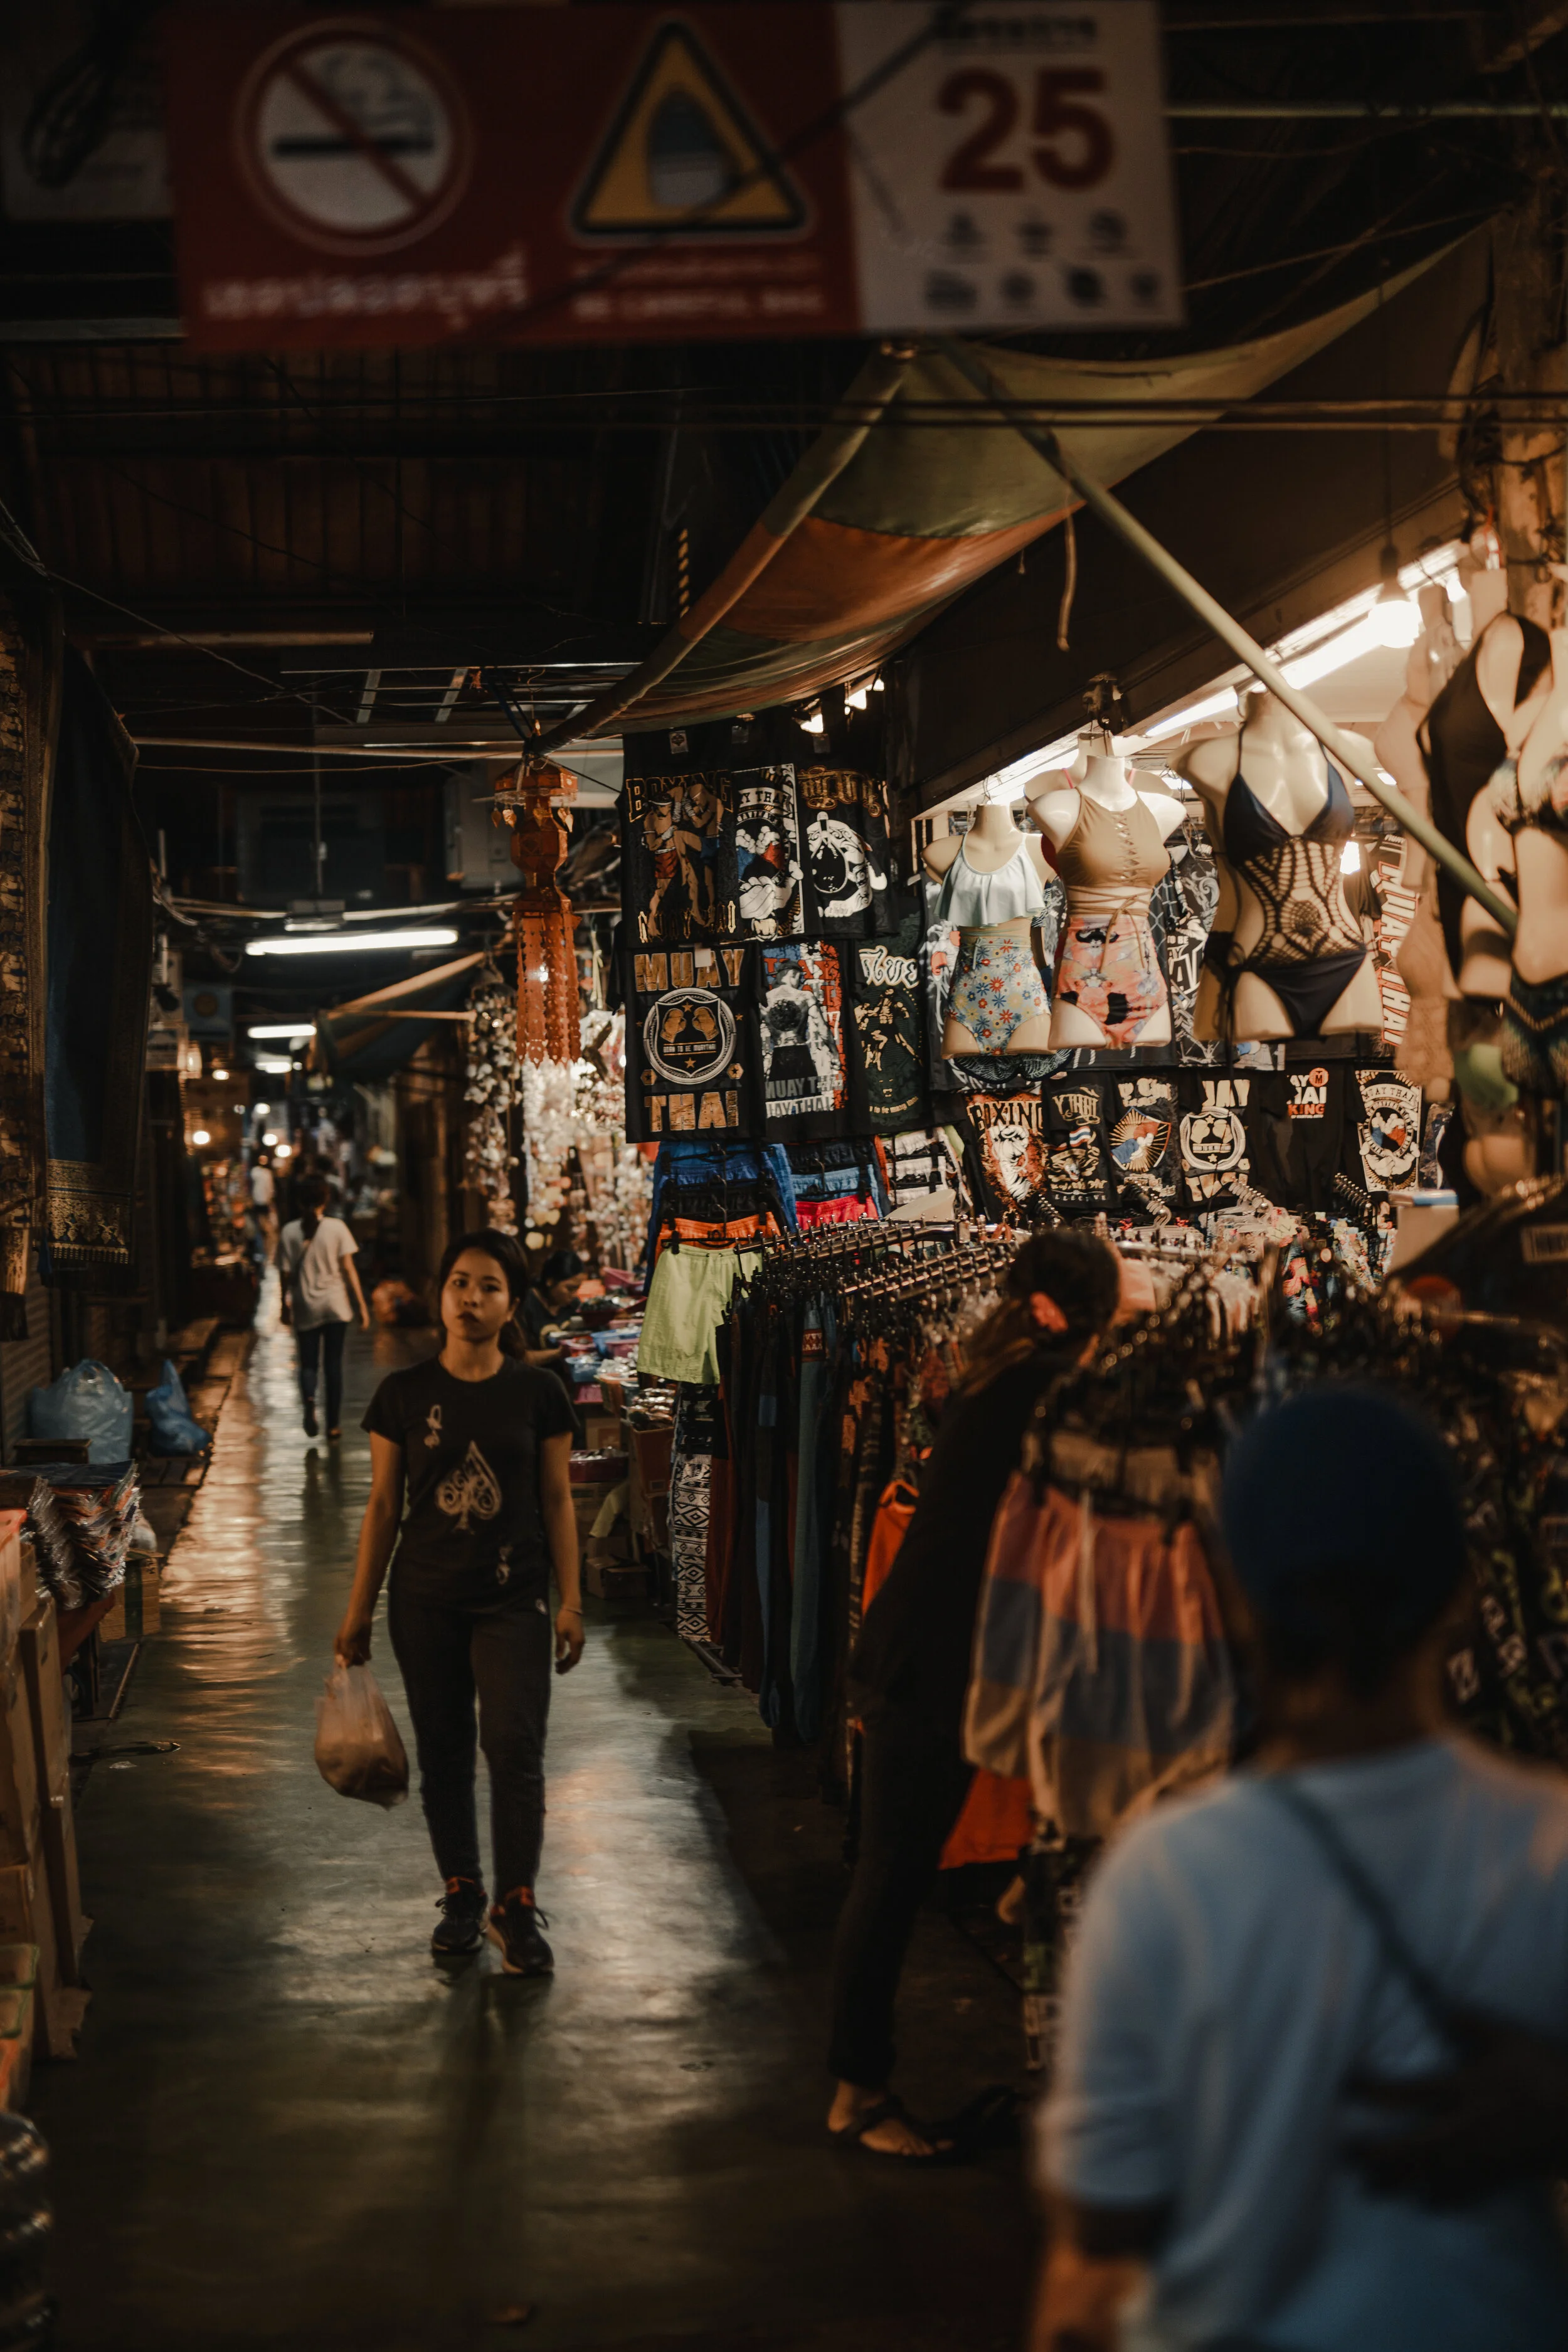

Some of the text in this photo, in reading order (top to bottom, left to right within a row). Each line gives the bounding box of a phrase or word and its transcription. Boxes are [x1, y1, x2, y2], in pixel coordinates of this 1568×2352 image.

[937, 66, 1115, 193] 25
[626, 769, 734, 823] BOG
[1177, 935, 1189, 945] BE
[634, 949, 745, 992] MUAY
[1290, 1075, 1310, 1087] AY
[1364, 1087, 1415, 1102] MUAY THAI
[644, 1091, 739, 1132] THAI
[1288, 1104, 1325, 1116] KING
